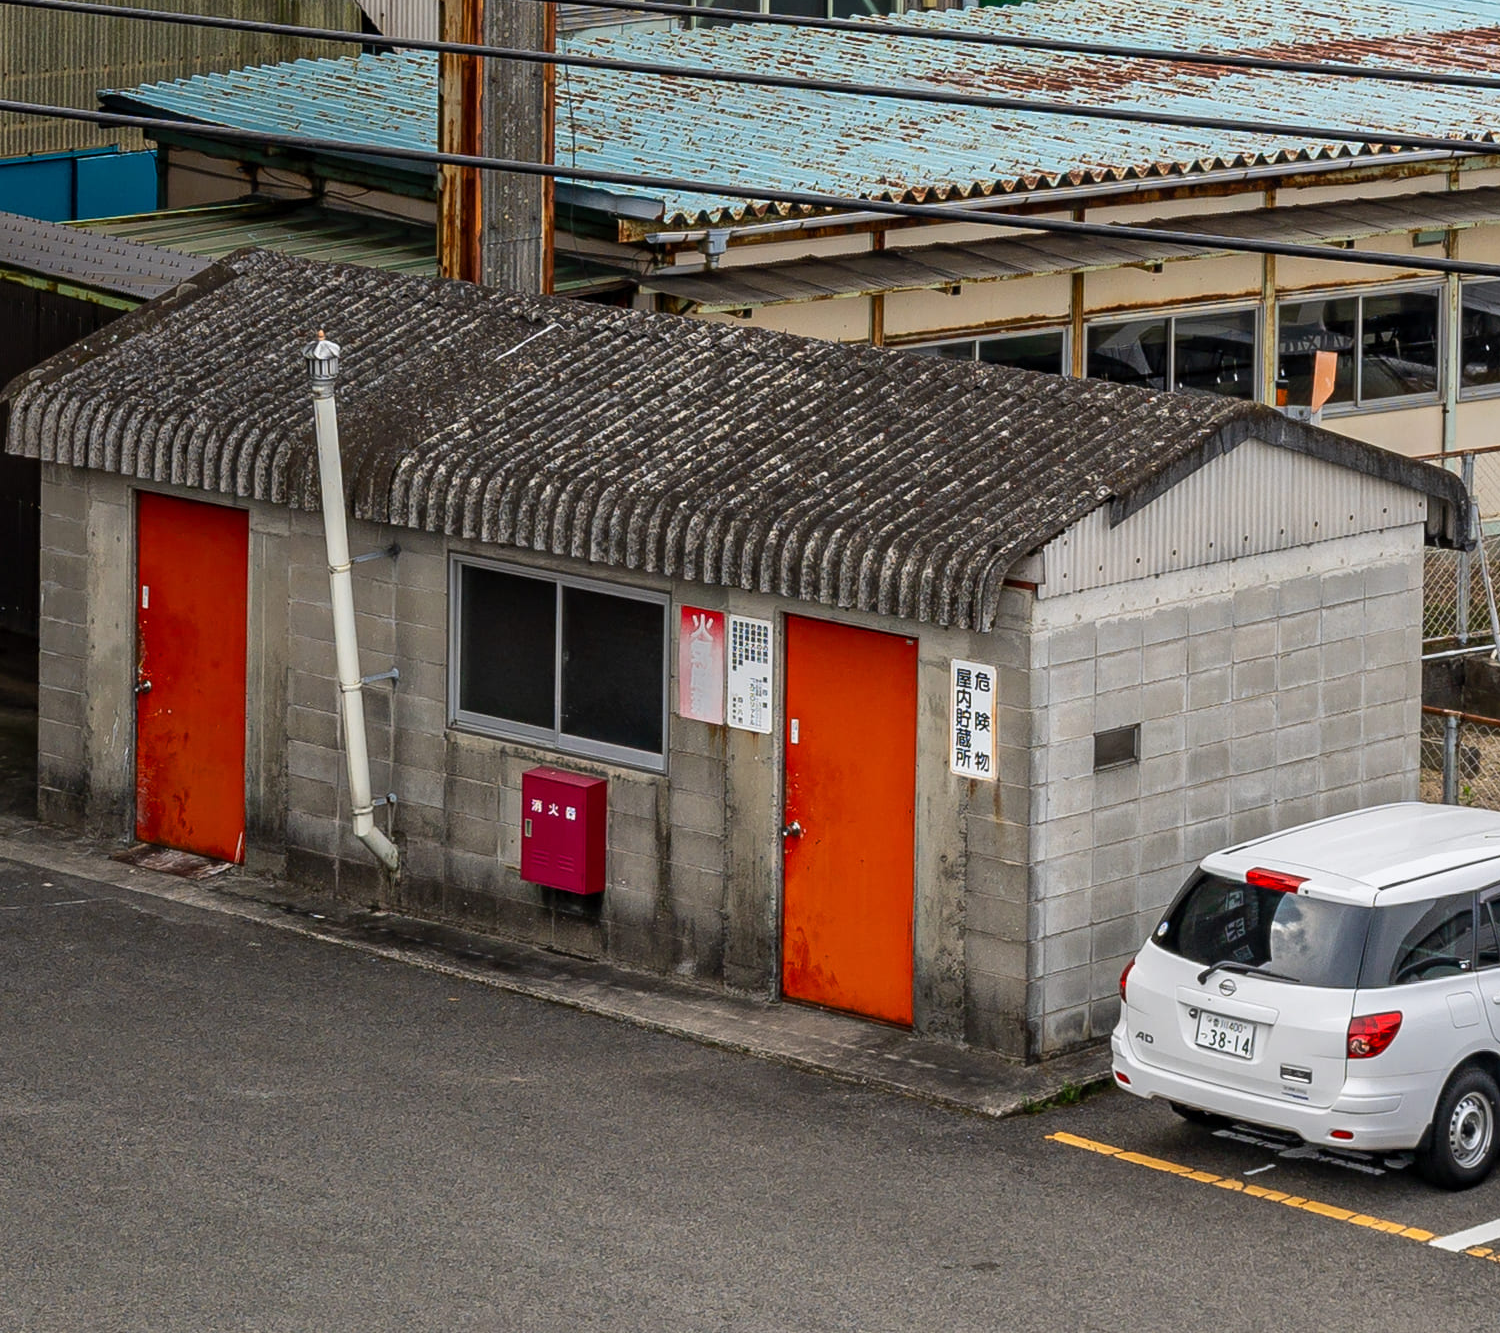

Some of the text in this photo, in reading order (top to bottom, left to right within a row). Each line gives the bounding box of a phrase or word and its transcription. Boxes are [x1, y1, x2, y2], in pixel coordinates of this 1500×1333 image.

[955, 668, 972, 769] 屋内貯蔵所
[974, 671, 991, 772] 危険物
[1135, 1031, 1154, 1044] AD
[1209, 1029, 1250, 1055] 38-14
